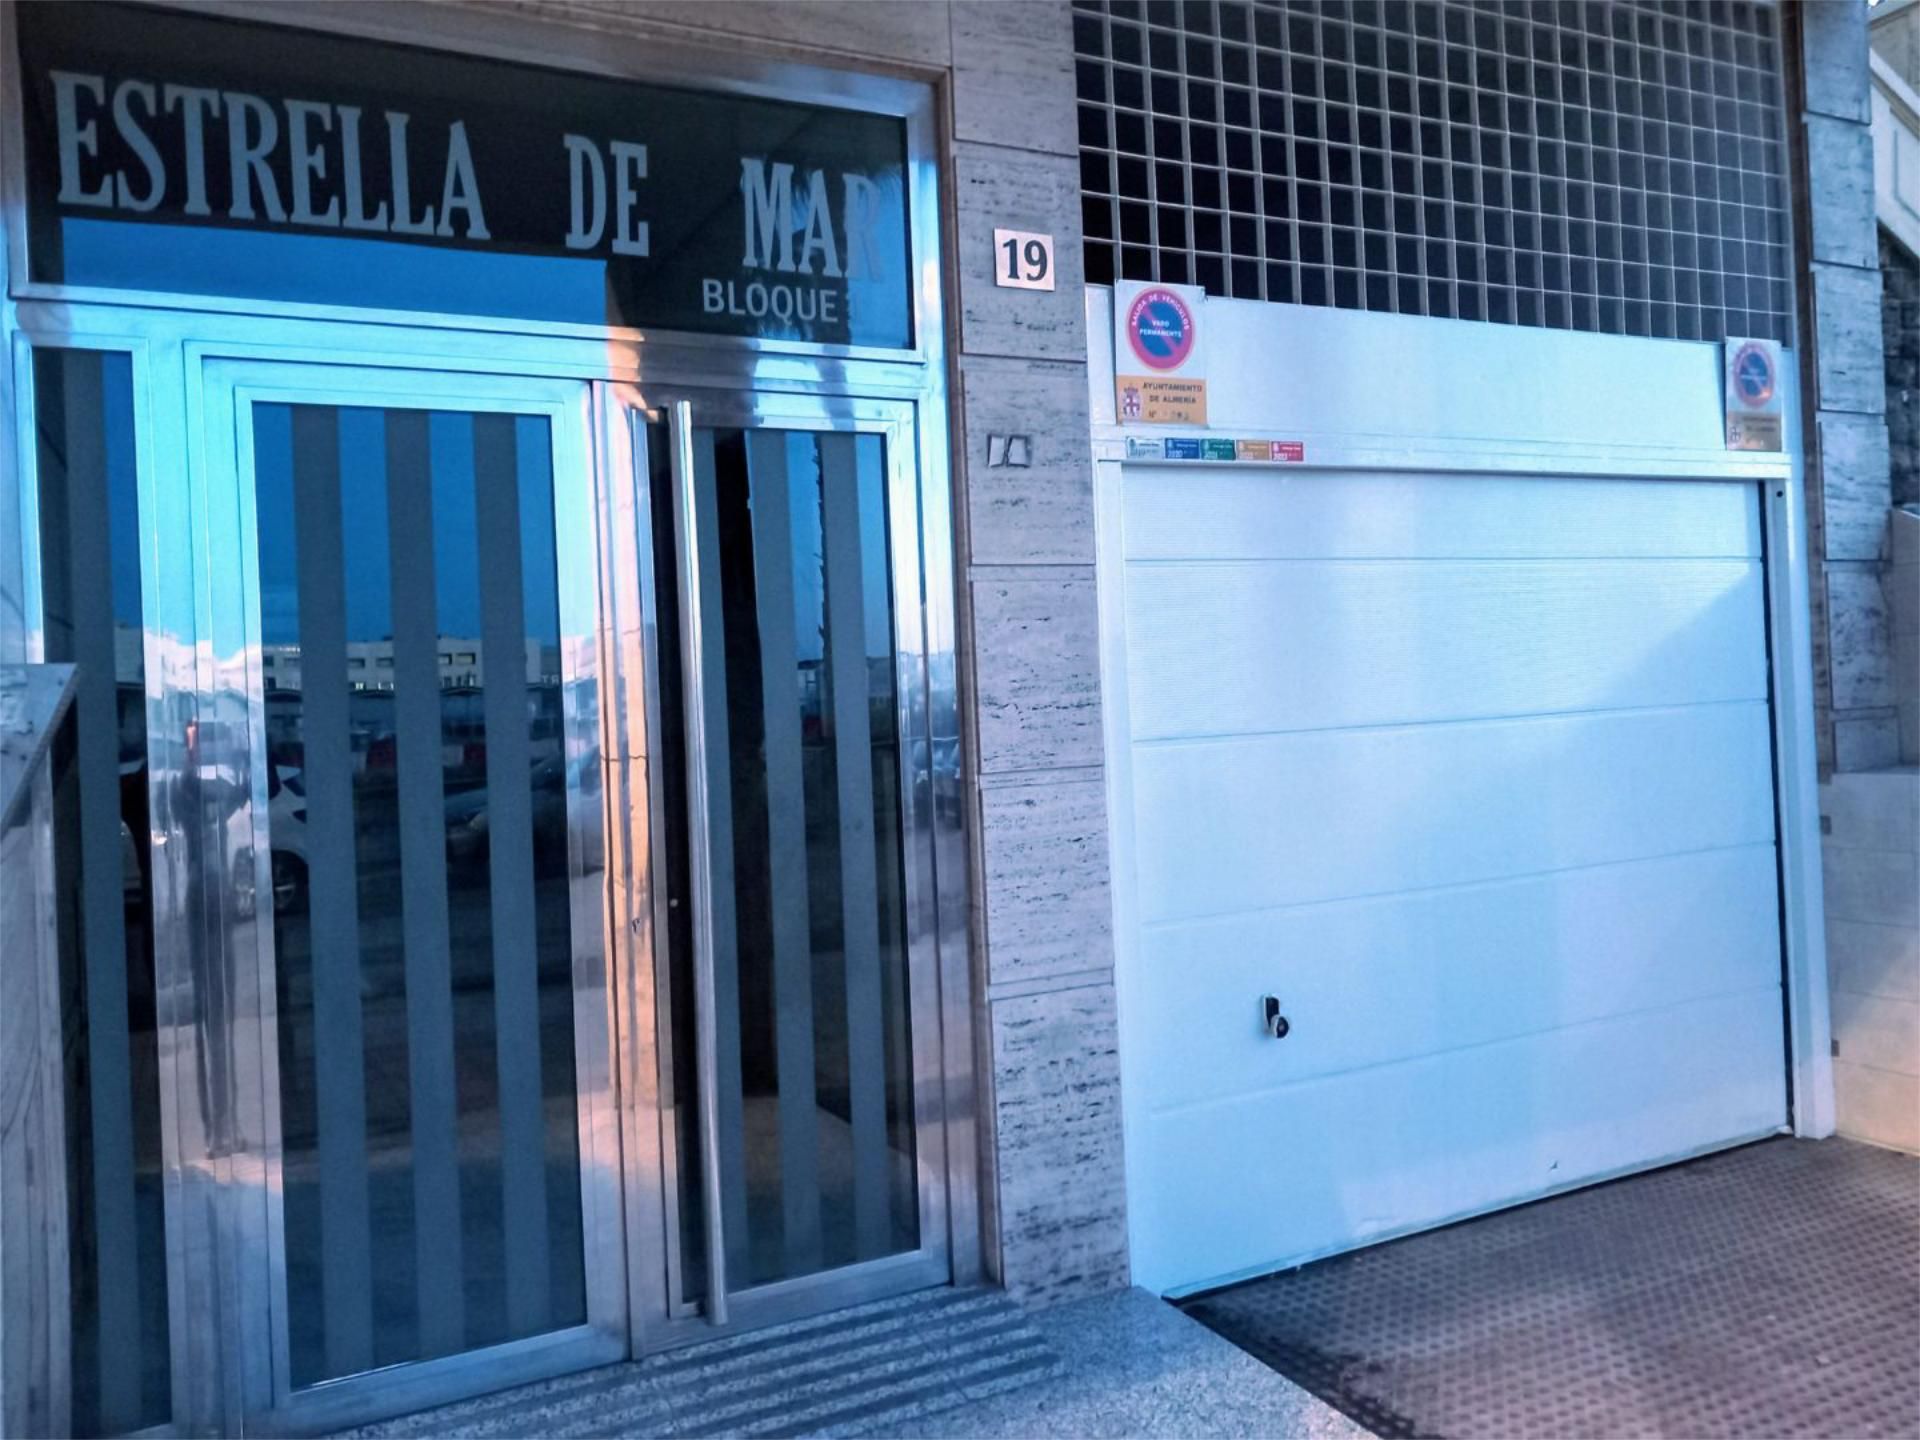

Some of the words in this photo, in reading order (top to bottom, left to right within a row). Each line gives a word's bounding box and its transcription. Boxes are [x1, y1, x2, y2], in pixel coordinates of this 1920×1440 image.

[50, 70, 491, 240] ESTRELLA
[563, 133, 649, 257] DE
[740, 157, 883, 284] MAR
[1002, 238, 1048, 282] 19
[702, 277, 839, 326] BLOQUE
[1151, 319, 1170, 328] VADO
[1139, 328, 1182, 338] PERMANENTE
[1142, 382, 1202, 393] AYUNTAMIENTO
[1149, 394, 1159, 403] DE
